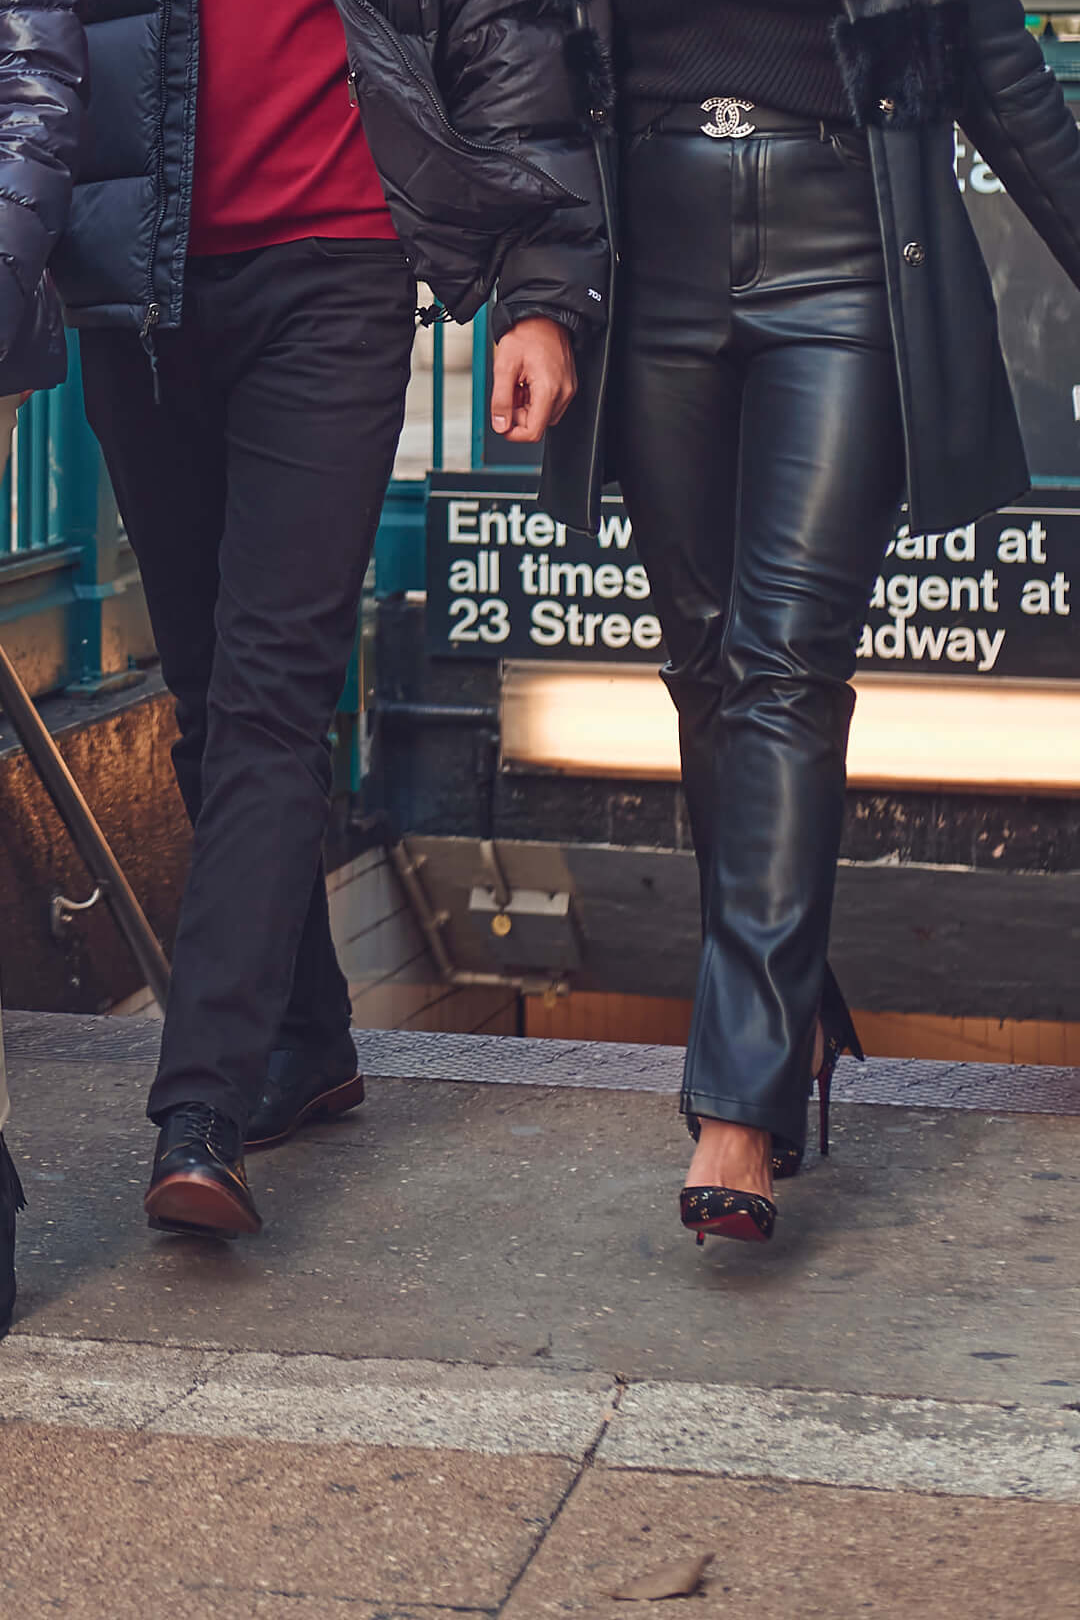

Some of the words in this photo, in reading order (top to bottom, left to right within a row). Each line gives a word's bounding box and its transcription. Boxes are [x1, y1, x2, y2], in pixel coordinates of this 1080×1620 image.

[447, 500, 567, 547] Enter
[884, 522, 976, 562] ard
[996, 519, 1048, 565] at
[448, 550, 500, 594] all
[518, 553, 651, 600] times
[1020, 571, 1071, 616] at
[448, 597, 511, 644] 23
[529, 599, 663, 649] Stree
